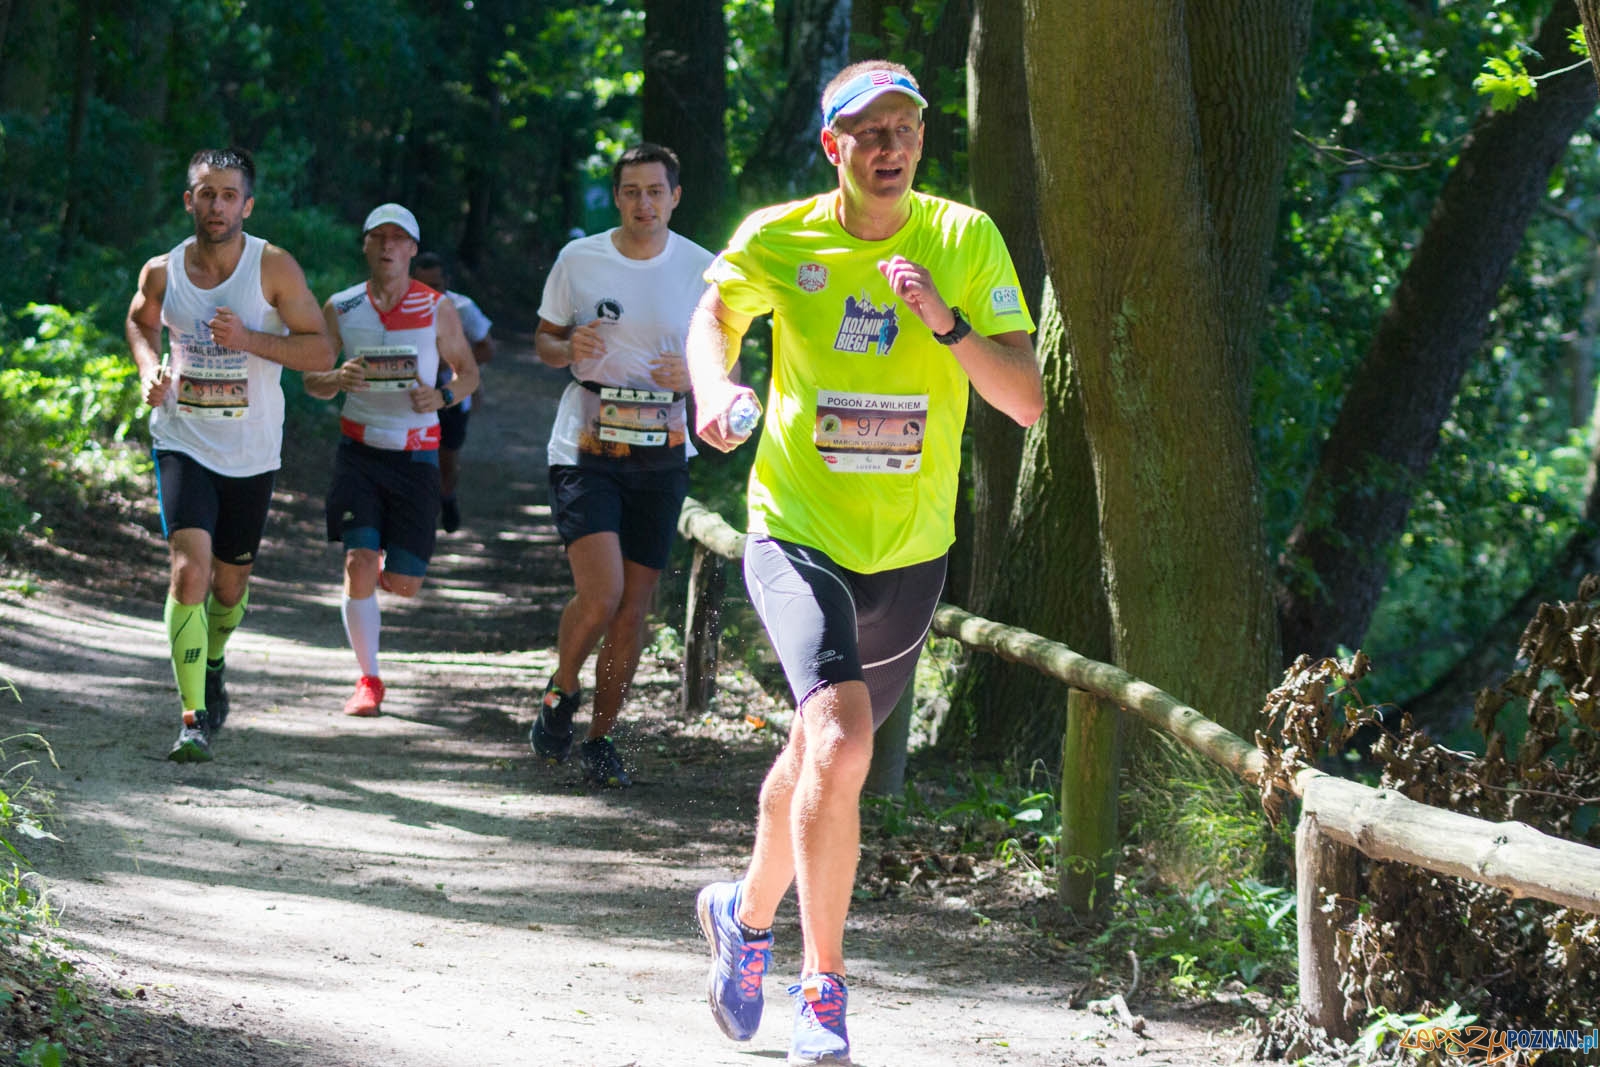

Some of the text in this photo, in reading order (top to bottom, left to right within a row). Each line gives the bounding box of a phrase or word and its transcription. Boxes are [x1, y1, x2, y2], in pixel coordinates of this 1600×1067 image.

[835, 333, 869, 352] BIEGA
[827, 396, 921, 410] POGOŃ ZA WILKIEM
[856, 416, 887, 437] 97
